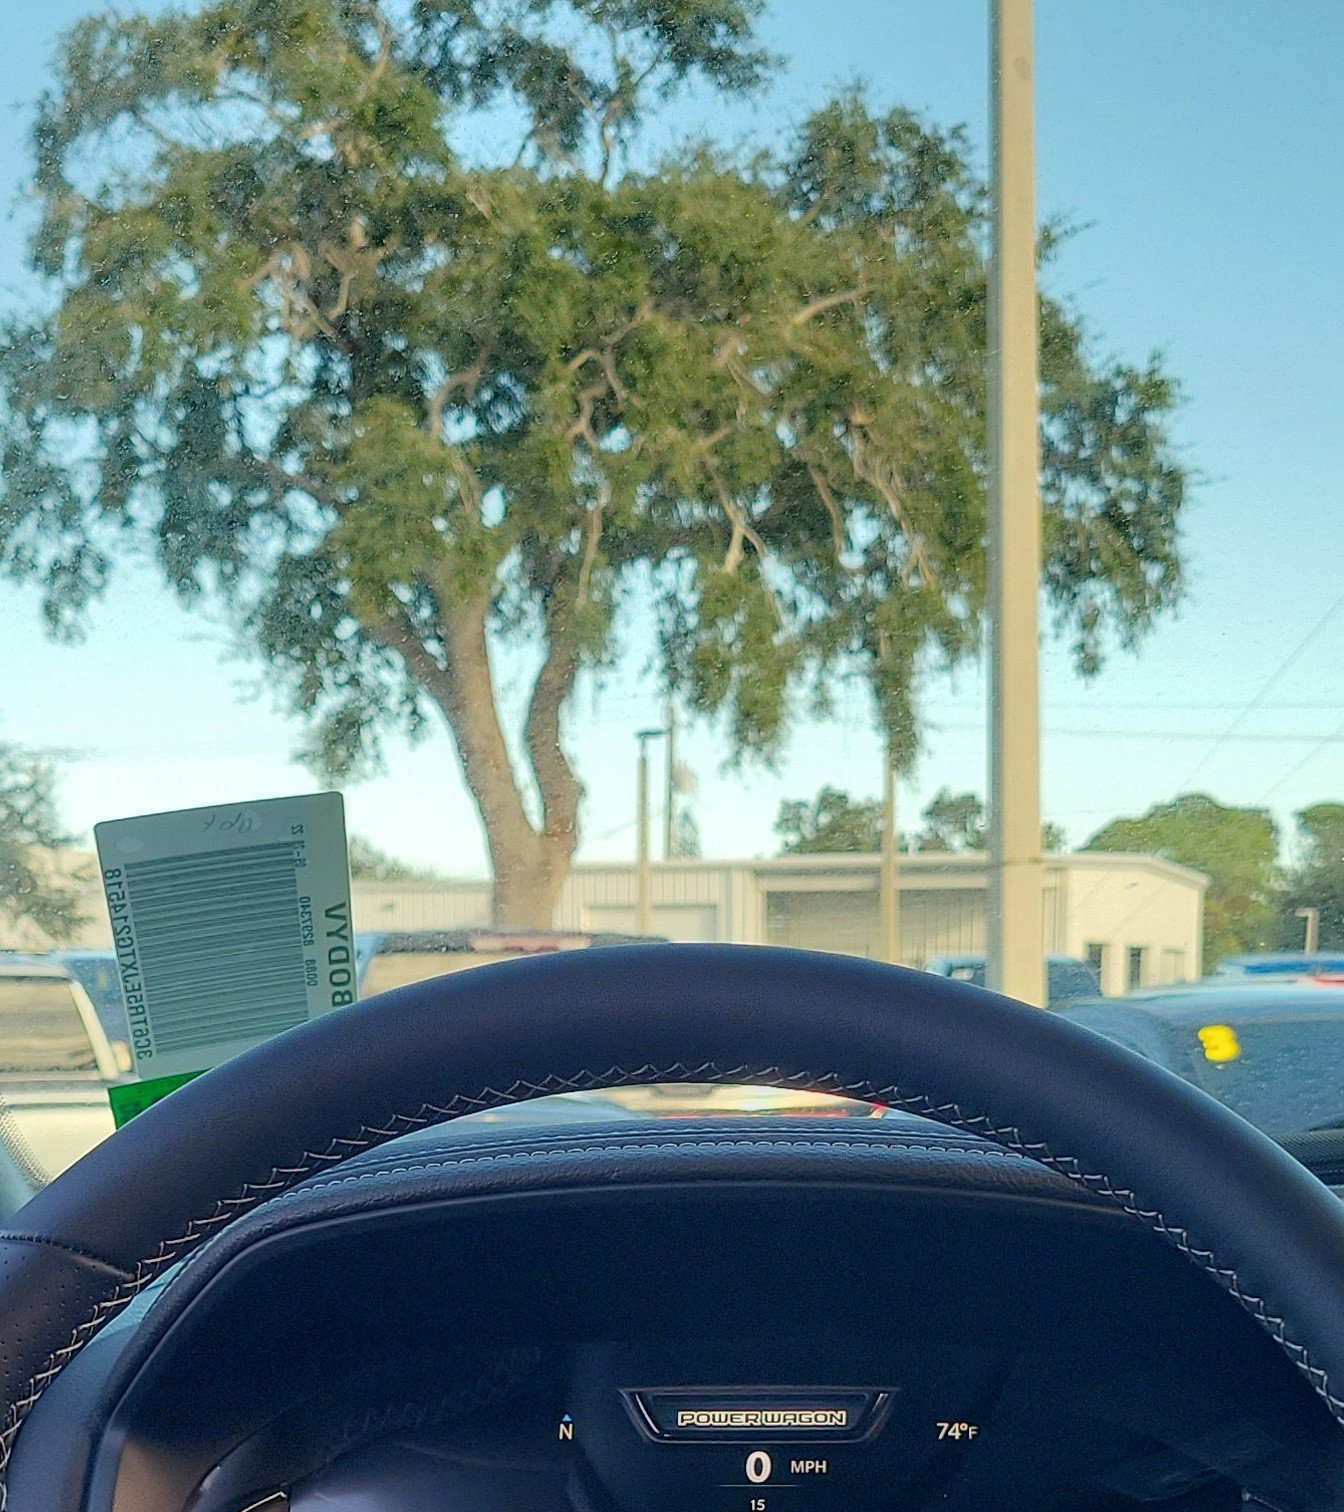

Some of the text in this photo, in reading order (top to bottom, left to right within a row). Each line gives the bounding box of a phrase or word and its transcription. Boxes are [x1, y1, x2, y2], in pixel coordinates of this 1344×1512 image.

[677, 1410, 846, 1428] POWER WAGON
[558, 1422, 574, 1441] N
[936, 1422, 978, 1441] 74°F
[746, 1451, 827, 1483] 0 MPH
[750, 1500, 766, 1512] 15
